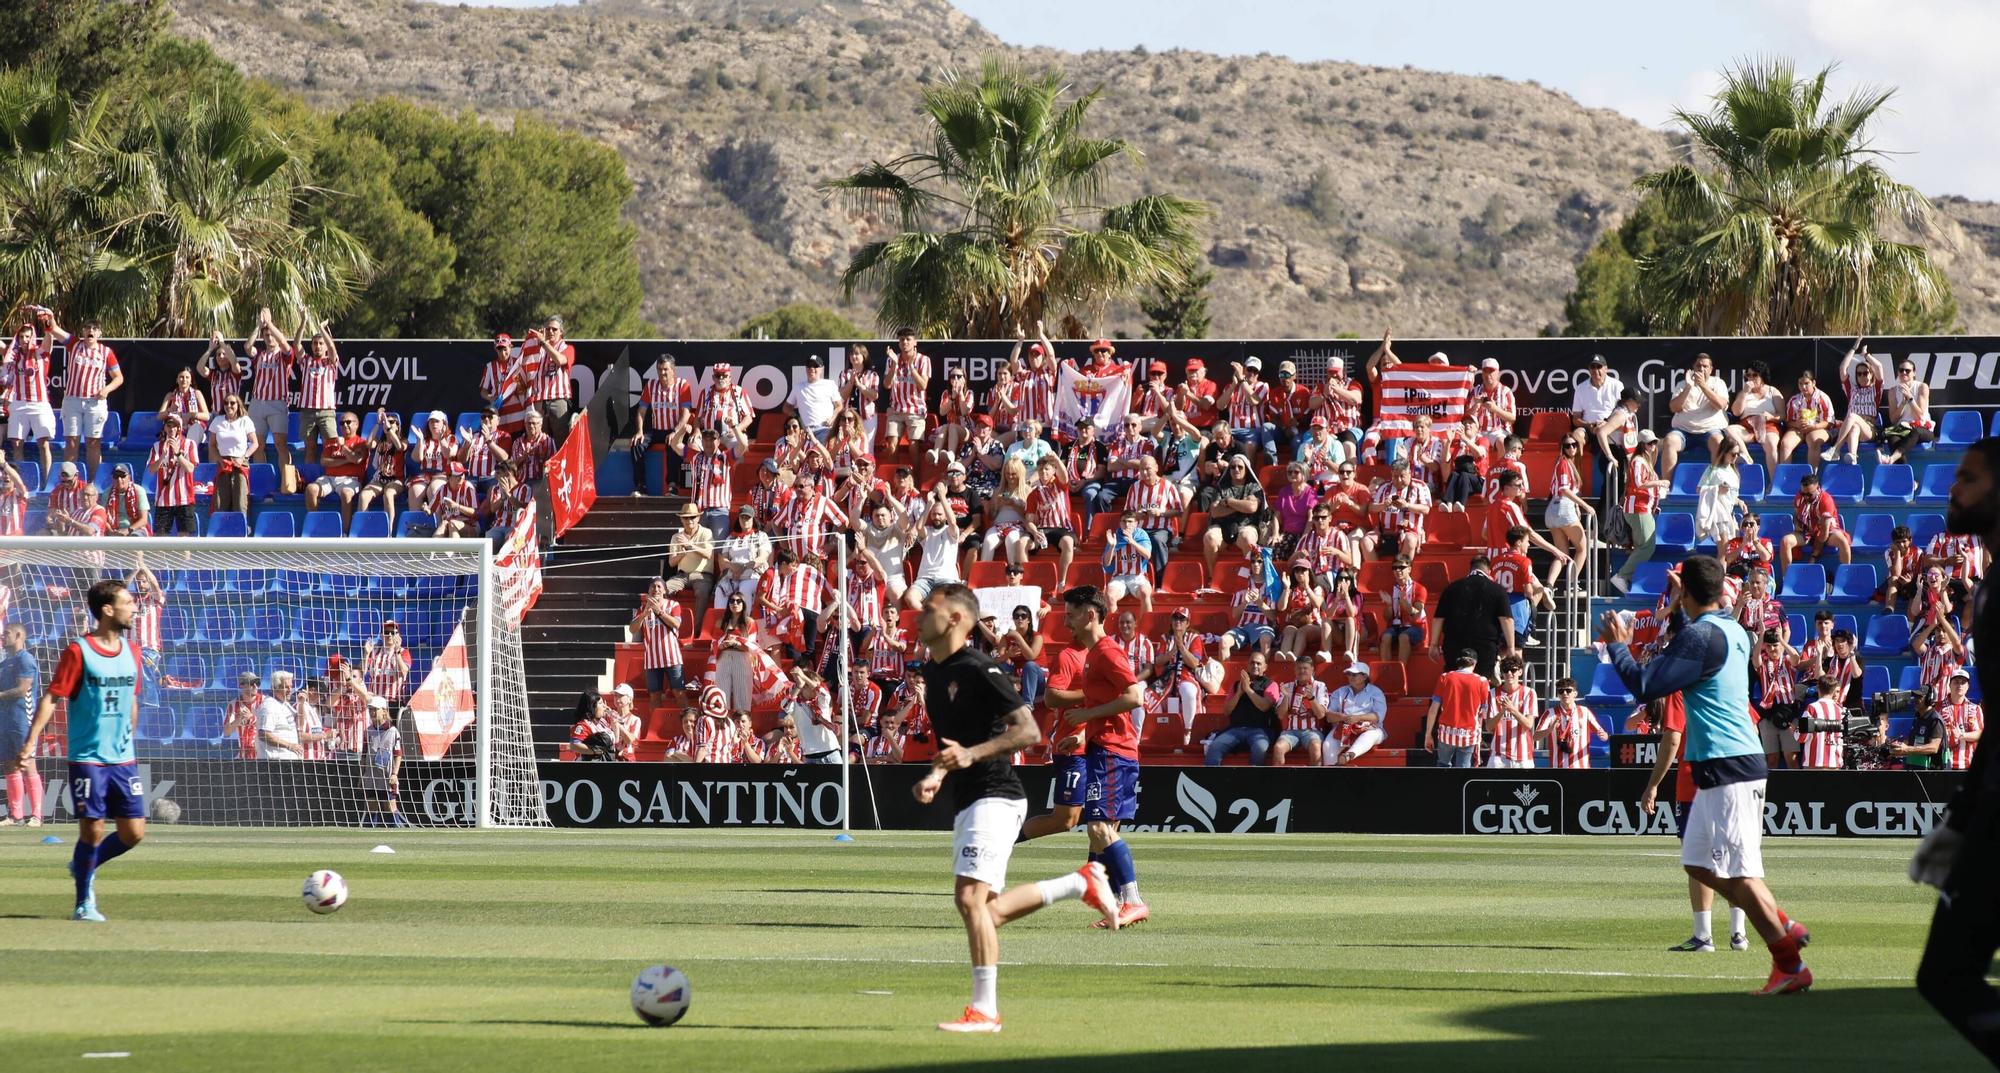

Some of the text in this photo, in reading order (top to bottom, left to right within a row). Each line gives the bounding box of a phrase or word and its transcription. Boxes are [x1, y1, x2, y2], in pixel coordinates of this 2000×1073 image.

[336, 351, 427, 381] MÓVIL
[943, 357, 1028, 381] FIBR
[347, 384, 392, 405] 1777
[1488, 479, 1501, 504] 2
[74, 778, 91, 798] 21
[1066, 771, 1080, 789] 17
[618, 768, 844, 826] SANTIÑO
[1228, 798, 1292, 833] 21
[1472, 804, 1552, 834] CRC
[1578, 800, 1680, 835] CAJA
[1760, 801, 1837, 836] RAL
